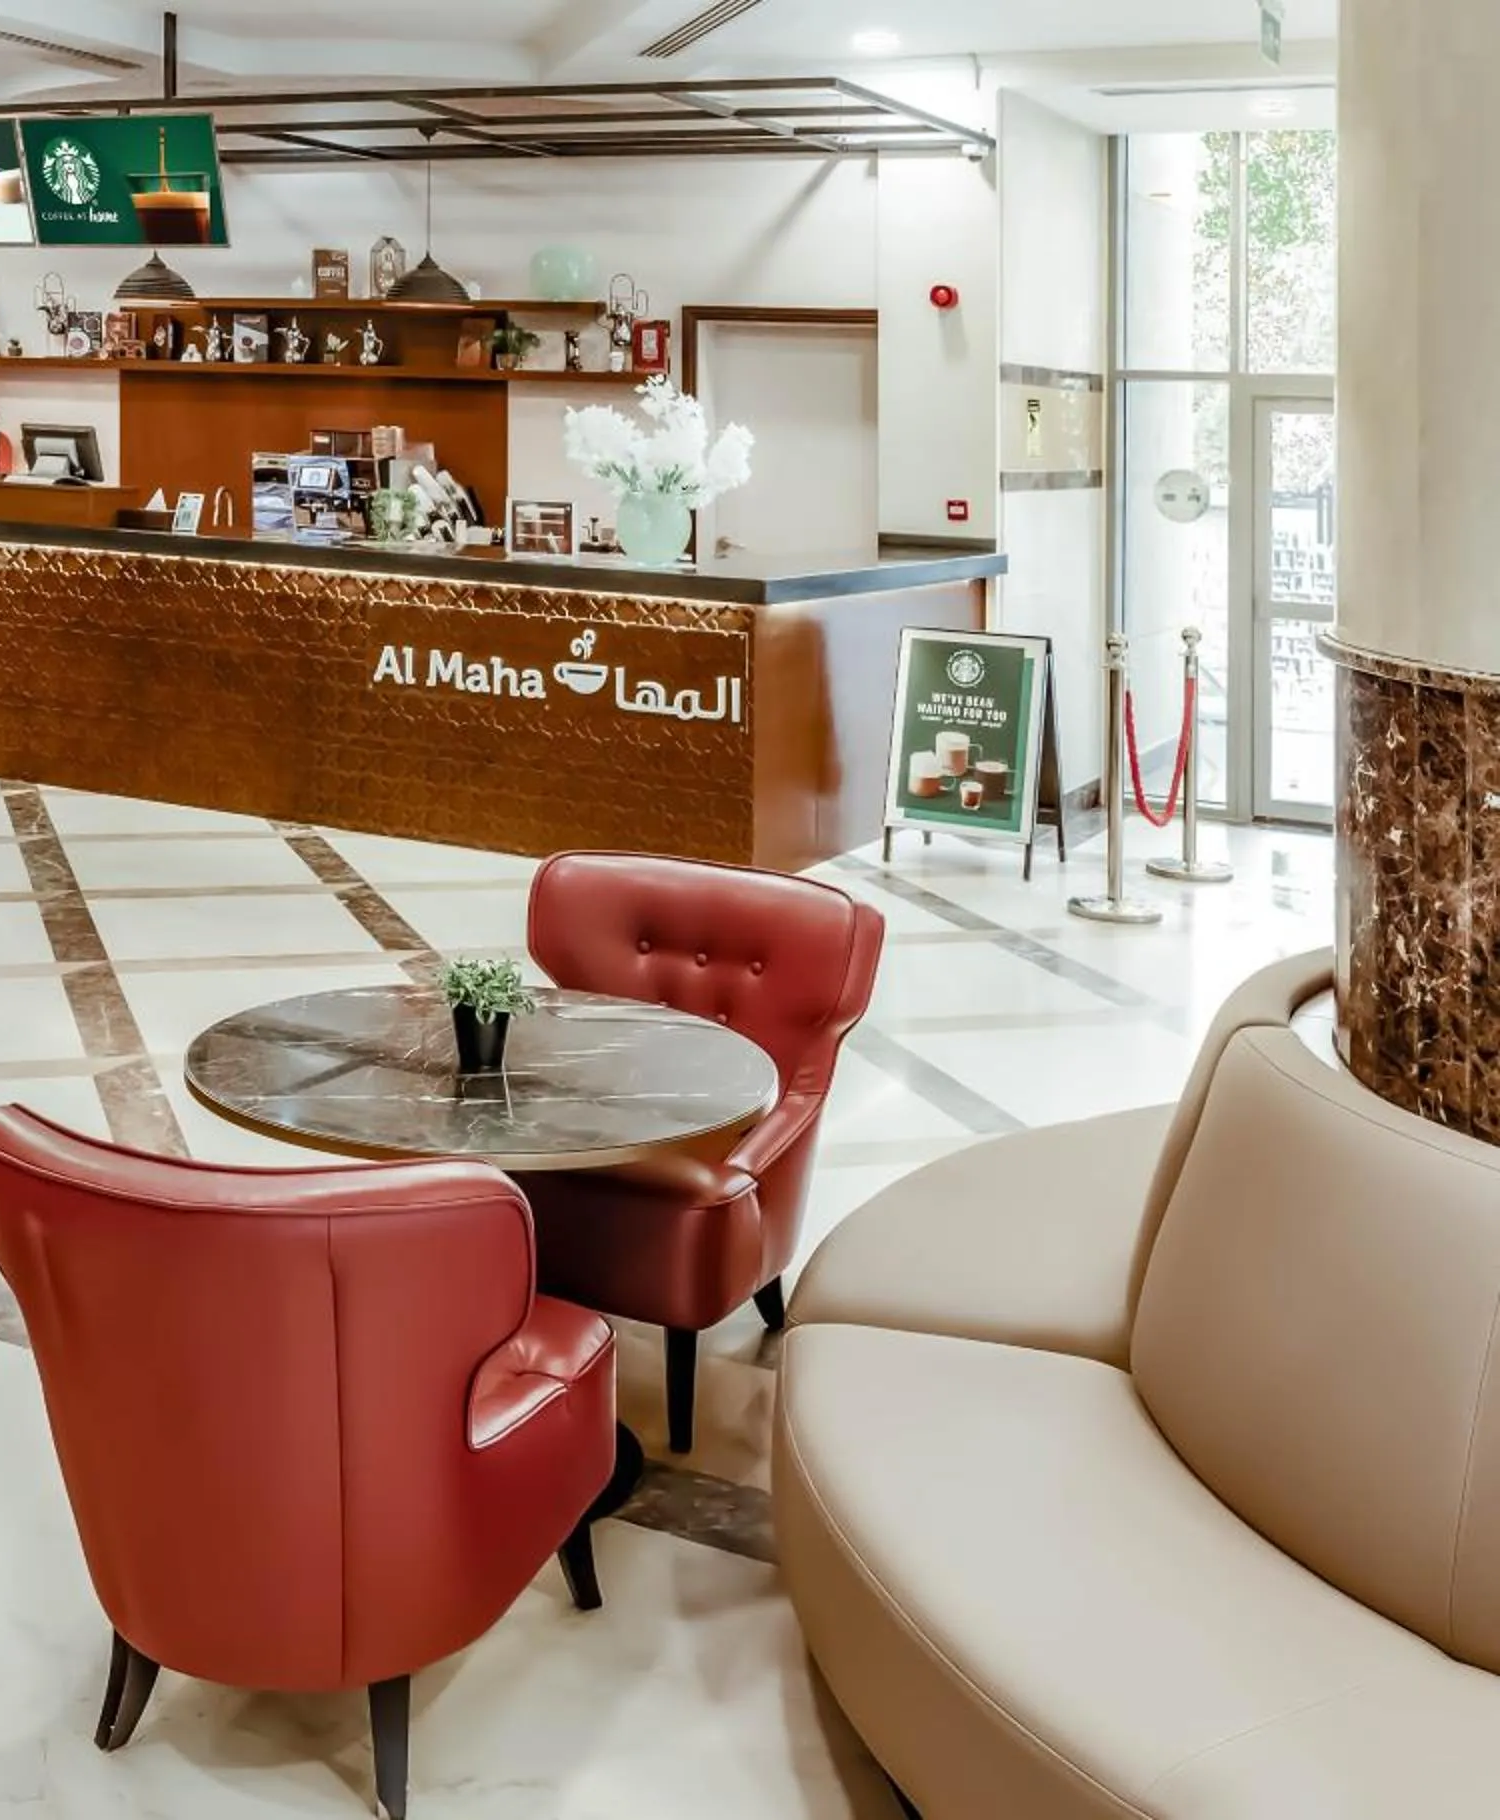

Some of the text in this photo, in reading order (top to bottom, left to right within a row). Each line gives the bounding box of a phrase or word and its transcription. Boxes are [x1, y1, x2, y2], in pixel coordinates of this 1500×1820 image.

[89, 206, 119, 223] home
[373, 645, 546, 699] Al Maha
[615, 666, 741, 723] المها
[917, 703, 961, 717] WAITING
[963, 707, 983, 719] FOR
[986, 710, 1007, 722] YOU
